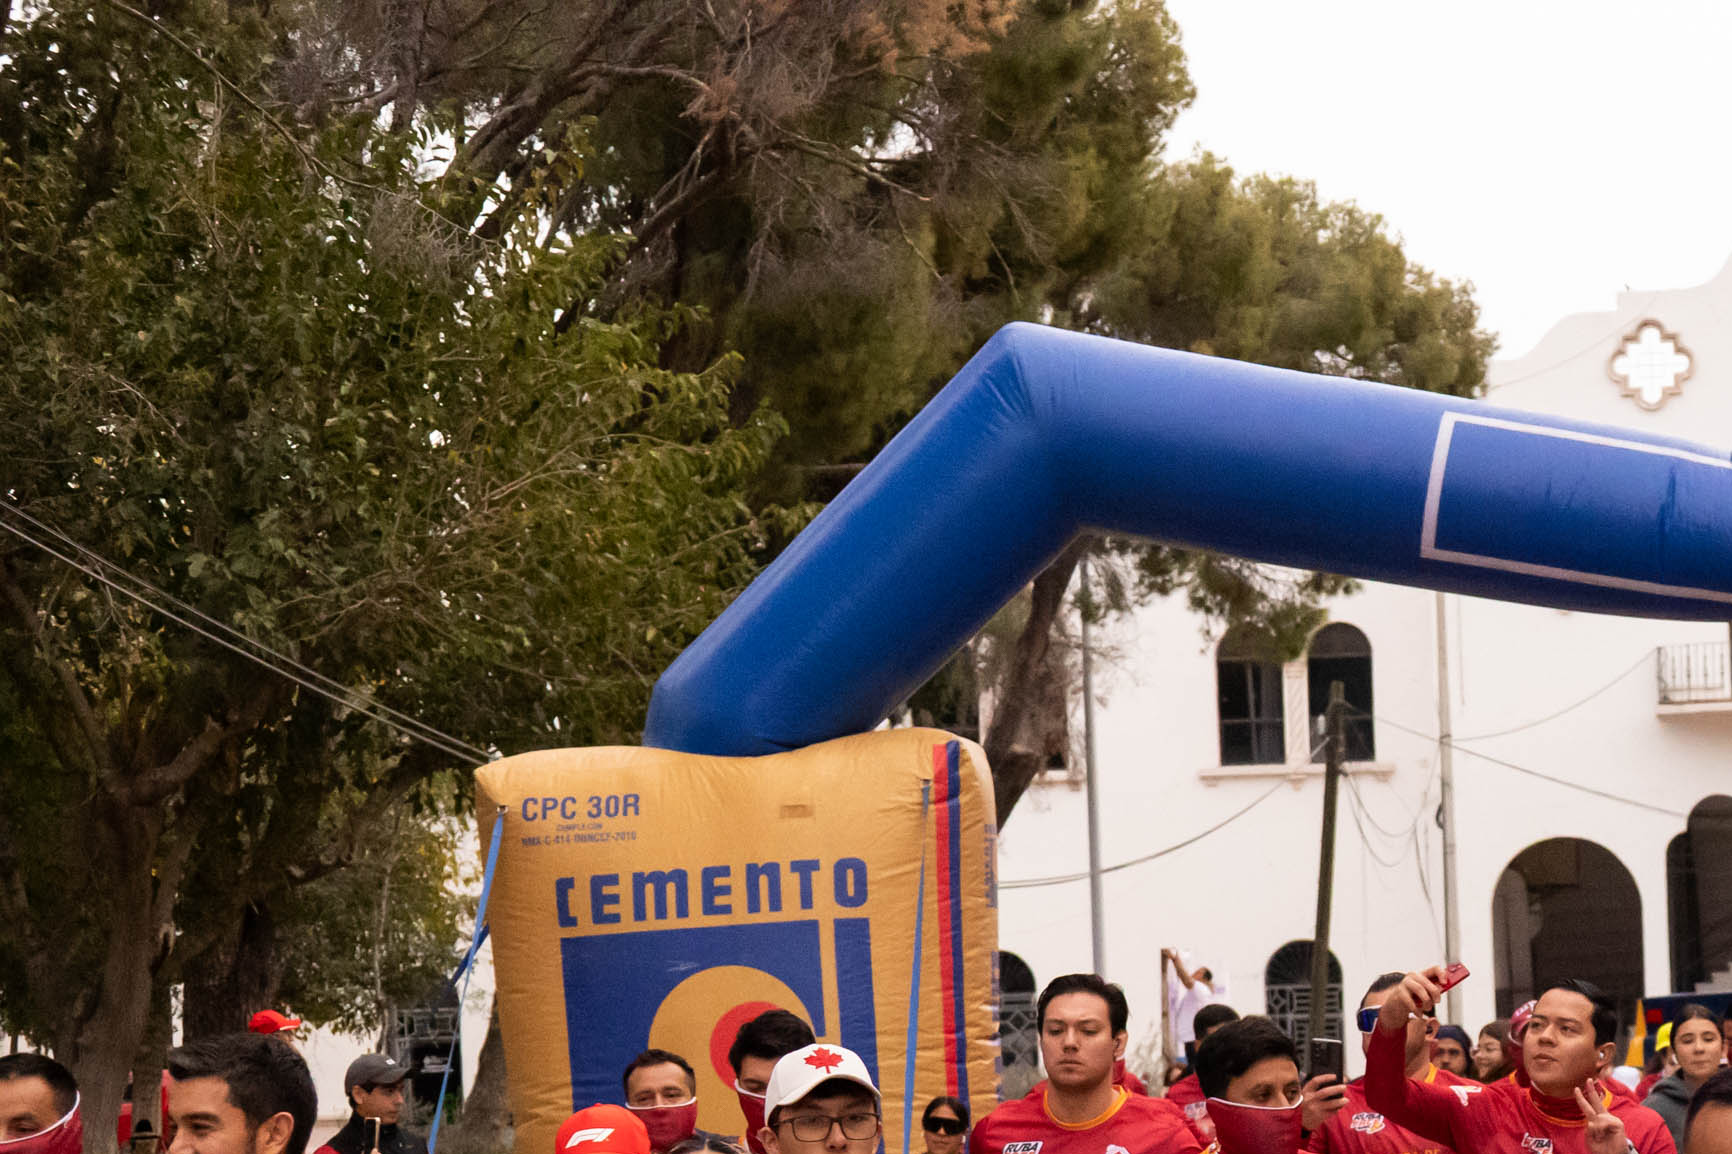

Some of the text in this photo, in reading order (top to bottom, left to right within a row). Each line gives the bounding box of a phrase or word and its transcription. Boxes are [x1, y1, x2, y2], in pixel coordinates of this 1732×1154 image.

[521, 793, 641, 822] CPC 30R
[1005, 1142, 1039, 1153] RUBA
